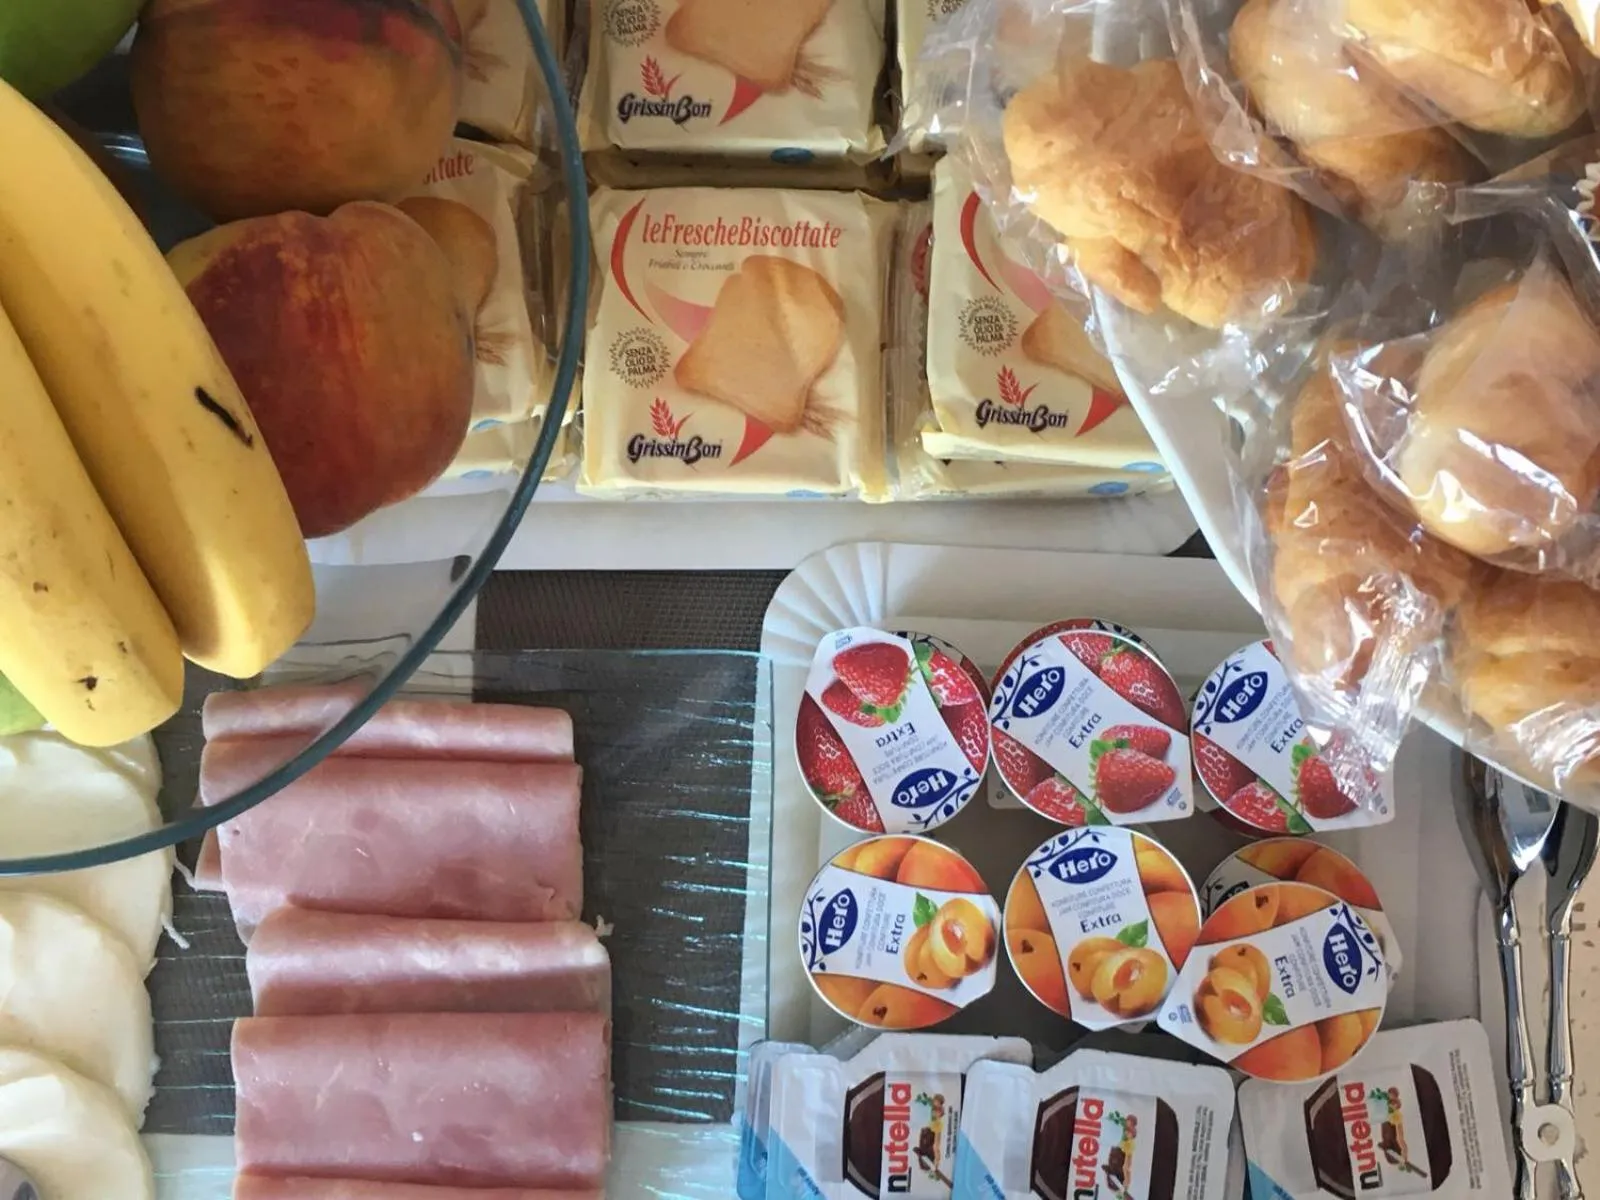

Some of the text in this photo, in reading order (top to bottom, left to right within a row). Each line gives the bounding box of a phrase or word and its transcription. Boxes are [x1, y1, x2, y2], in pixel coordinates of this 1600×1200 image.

[618, 93, 711, 124] GrissinBon
[642, 213, 842, 248] leFrescheBiscottate
[625, 347, 652, 357] SENZA
[976, 332, 1004, 343] PALMA
[625, 356, 645, 367] OLIO
[628, 364, 657, 376] PALMA
[976, 398, 1069, 433] GrissinBon
[627, 433, 722, 466] GrissinBon
[1018, 669, 1060, 716] Hero
[1220, 674, 1263, 721] Hero
[876, 722, 916, 748] Extra
[1068, 713, 1102, 749] Extra
[1270, 717, 1304, 754] Extra
[897, 771, 949, 805] Hero
[1058, 851, 1111, 880] Hero
[825, 893, 850, 947] Hero
[886, 914, 905, 955] Extra
[1080, 912, 1122, 933] Extra
[1274, 956, 1295, 999] Extra
[1328, 932, 1357, 989] Hero
[884, 1084, 911, 1193] nutella
[1072, 1098, 1104, 1200] nutella
[1342, 1082, 1382, 1190] nutella
